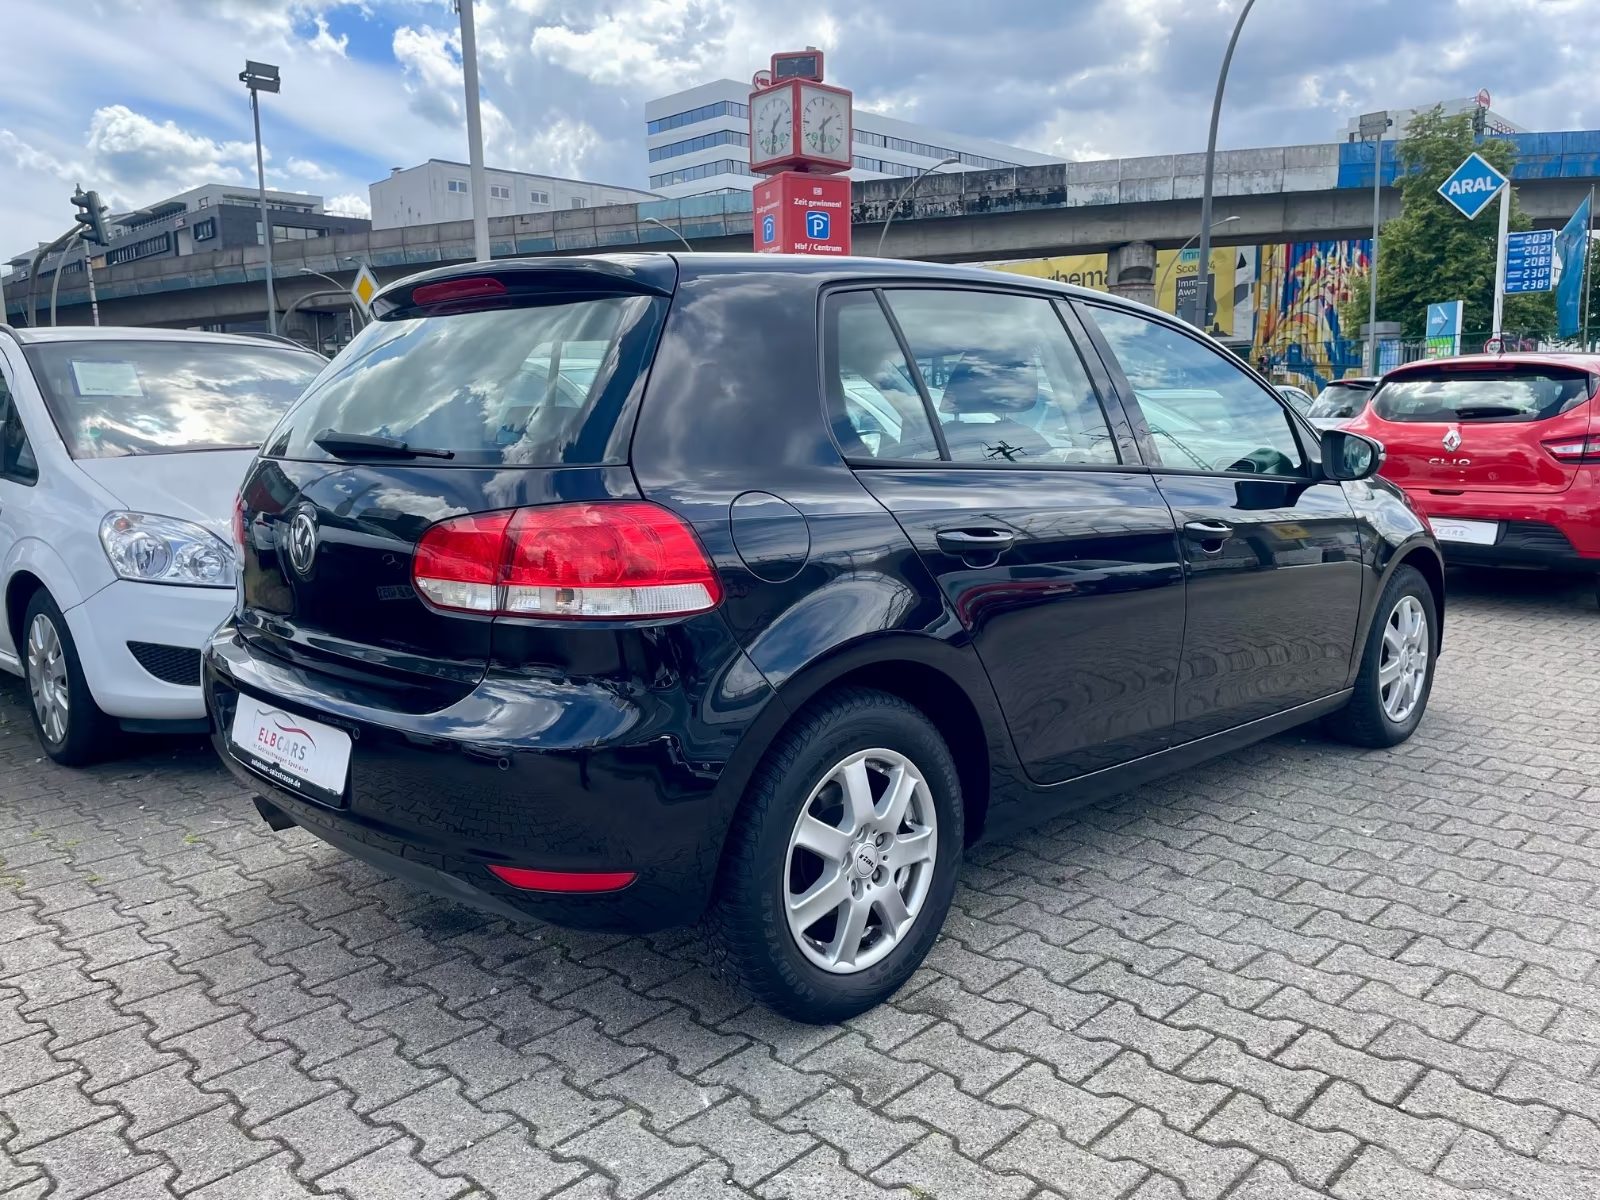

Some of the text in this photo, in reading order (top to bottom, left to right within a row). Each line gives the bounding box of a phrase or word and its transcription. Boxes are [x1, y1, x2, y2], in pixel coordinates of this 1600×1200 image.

[1448, 175, 1497, 196] ARAL
[793, 198, 842, 208] Zeit gewinnen!
[766, 223, 772, 240] P
[813, 219, 824, 236] P
[813, 244, 842, 252] Centrum
[1182, 250, 1200, 261] Imm
[1176, 260, 1216, 274] Scou4
[1178, 279, 1197, 288] Imm
[1177, 288, 1196, 297] Awa
[1428, 458, 1471, 466] CLIO
[258, 727, 307, 761] ELBCARS
